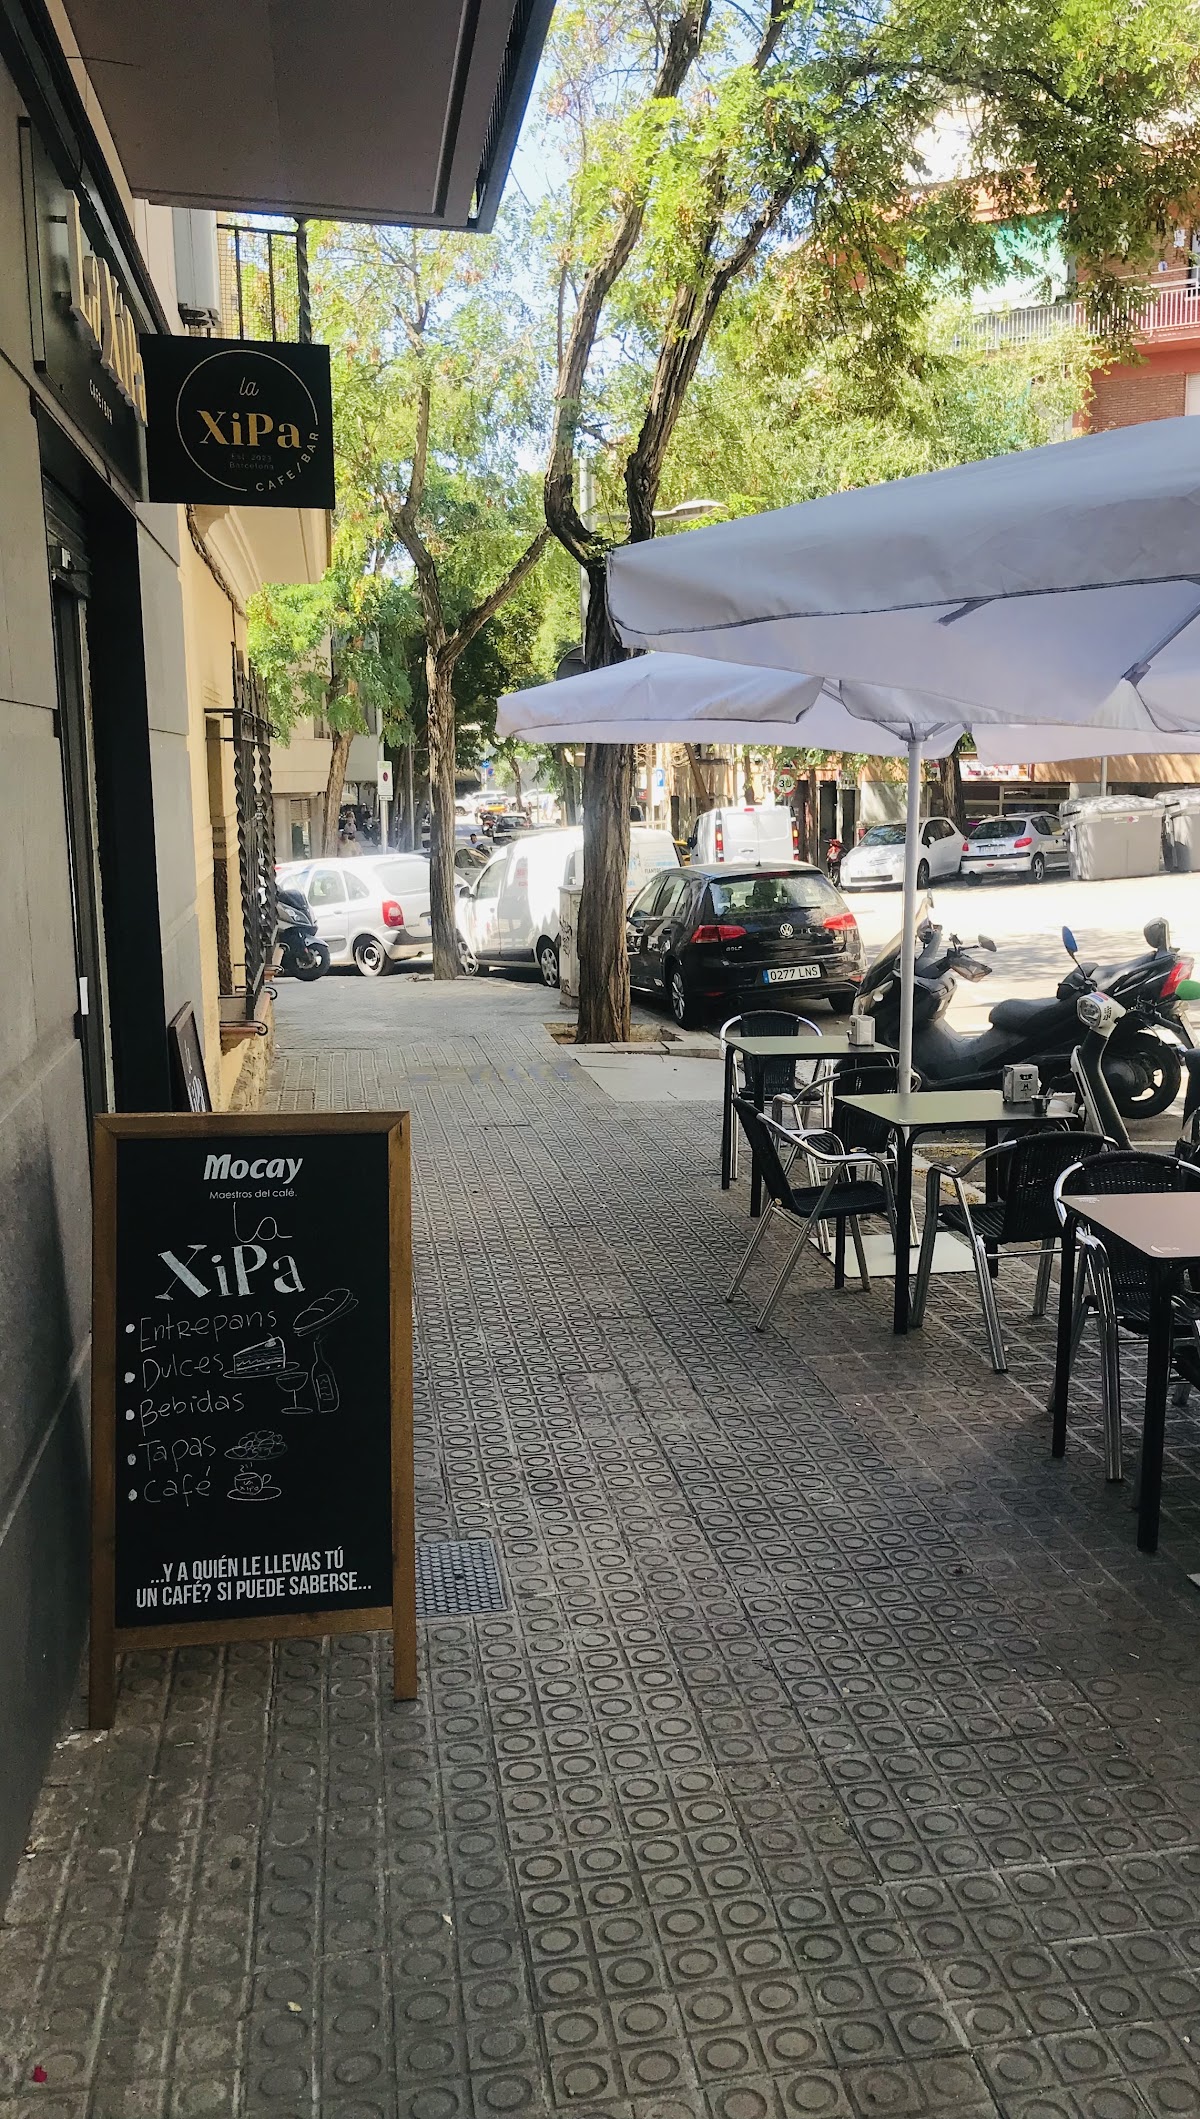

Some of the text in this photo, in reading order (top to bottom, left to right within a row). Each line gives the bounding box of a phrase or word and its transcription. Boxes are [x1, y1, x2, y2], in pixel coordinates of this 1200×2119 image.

[196, 409, 302, 449] XiPa
[229, 461, 275, 470] Barcelona
[770, 966, 819, 981] 0277 LNS
[203, 1153, 304, 1185] Mocay
[209, 1190, 253, 1199] Maestros
[254, 1189, 270, 1198] del
[155, 1244, 306, 1300] XiPa
[142, 1352, 225, 1392] Dulces
[139, 1390, 245, 1436] Bebidas
[139, 1436, 217, 1472] Tapas
[177, 1561, 189, 1581] A
[192, 1554, 239, 1581] QUIÉN
[242, 1557, 262, 1576] LE
[264, 1551, 321, 1574] LLEVAS
[324, 1546, 345, 1569] TÚ
[136, 1571, 372, 1608] UN CAFÉ? SI PUEDE SABERSE...
